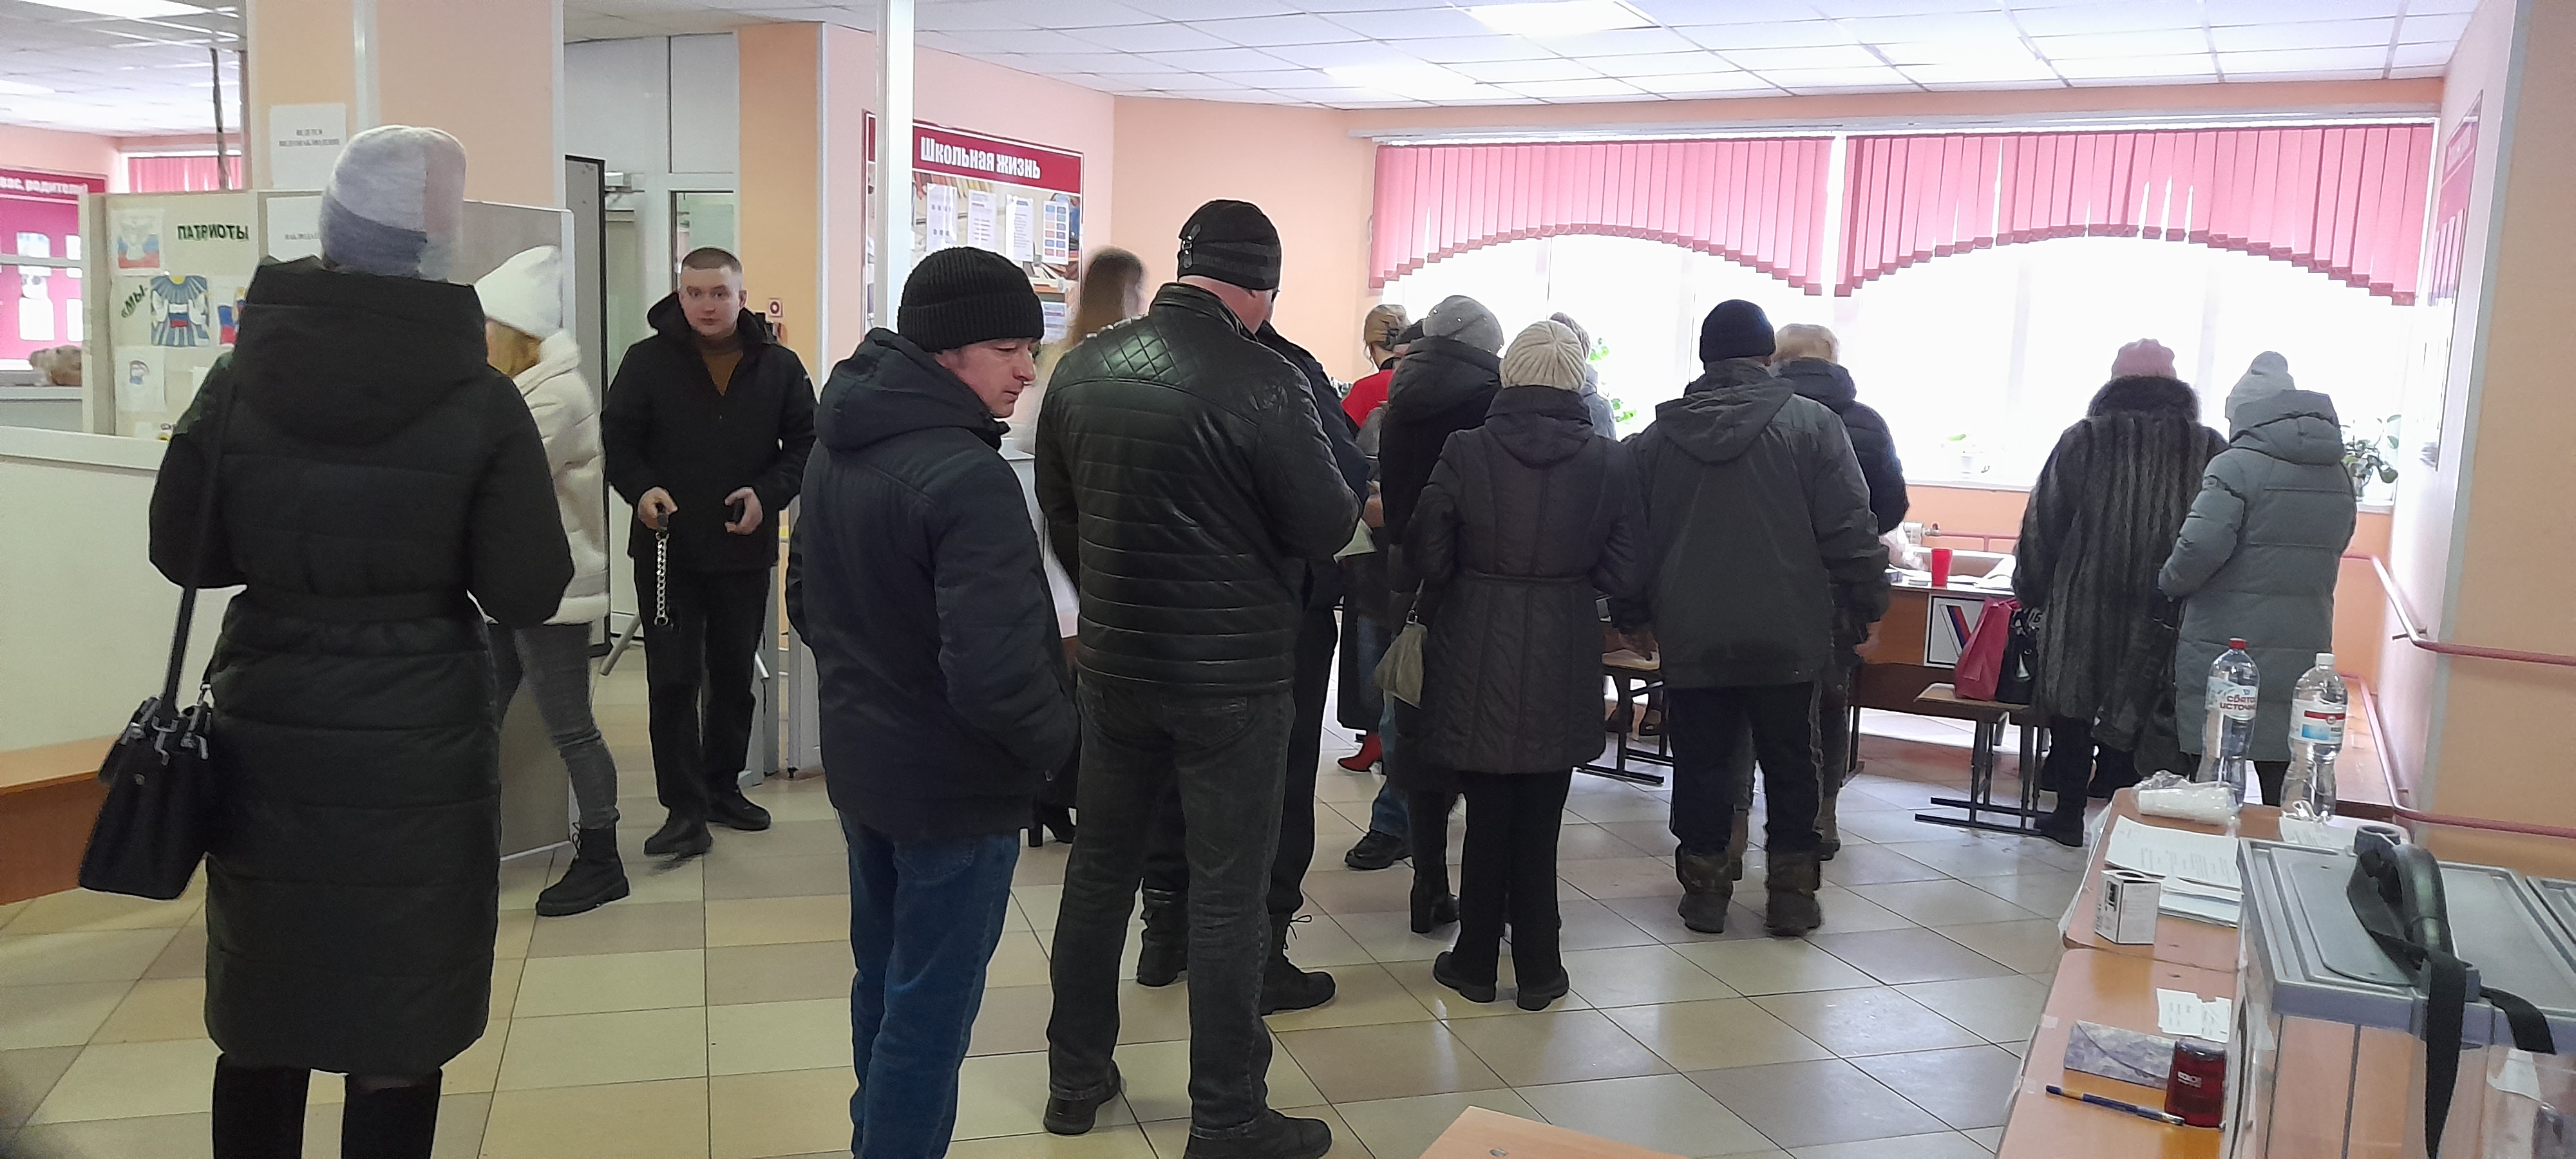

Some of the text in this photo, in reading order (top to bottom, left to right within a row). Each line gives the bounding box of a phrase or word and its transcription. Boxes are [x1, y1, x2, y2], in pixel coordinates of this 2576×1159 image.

[920, 136, 1041, 180] Школьная жизнь
[177, 223, 249, 241] ПАТРИОТЫ
